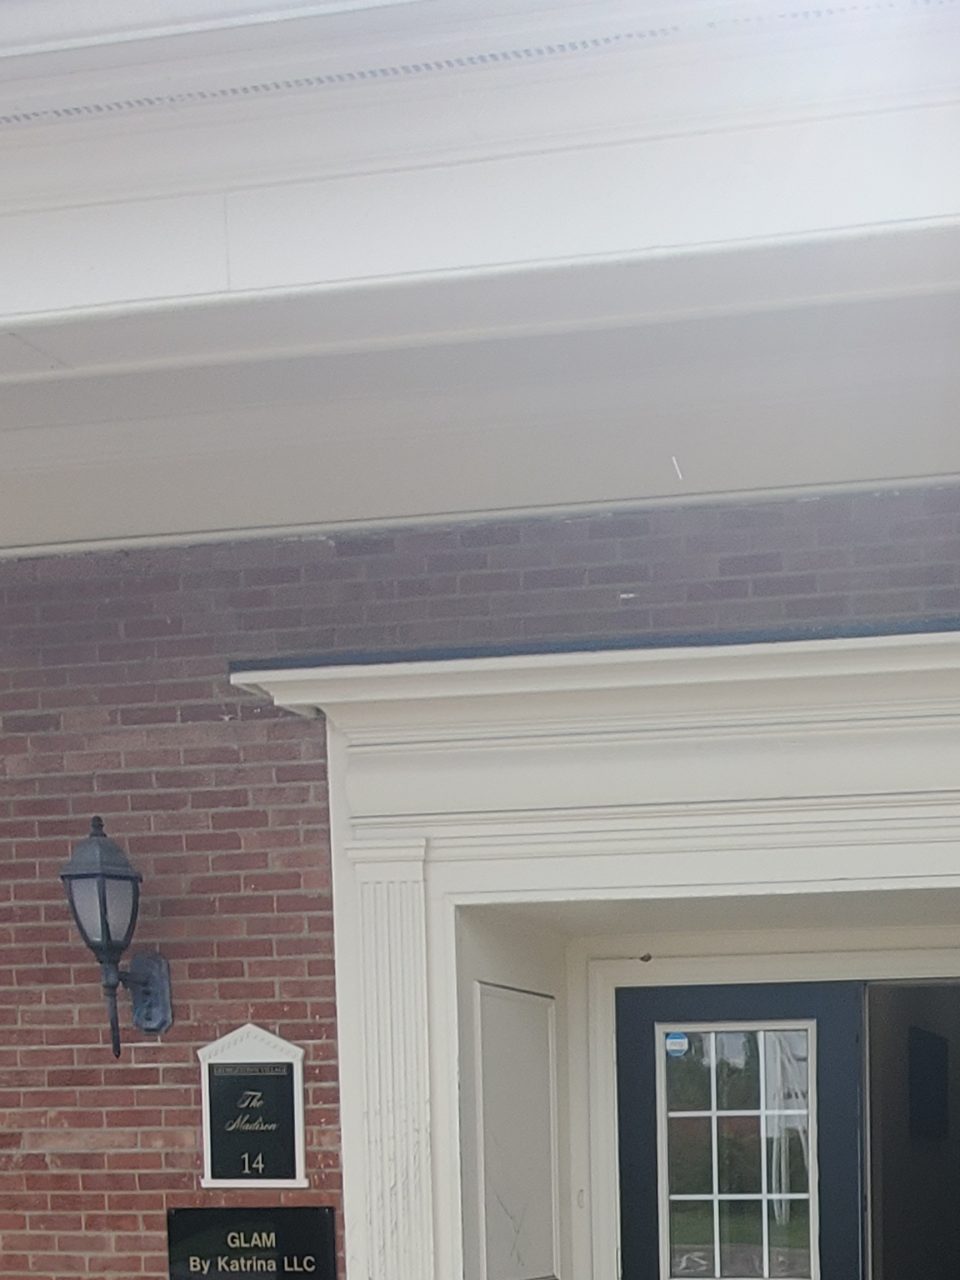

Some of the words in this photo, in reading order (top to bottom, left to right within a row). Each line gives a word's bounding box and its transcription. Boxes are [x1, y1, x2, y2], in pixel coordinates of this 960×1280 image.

[237, 1091, 264, 1108] The
[240, 1152, 264, 1174] 14
[227, 1232, 276, 1248] GLAM
[189, 1257, 210, 1275] By
[217, 1256, 277, 1272] Katrina
[283, 1256, 316, 1272] LLC
